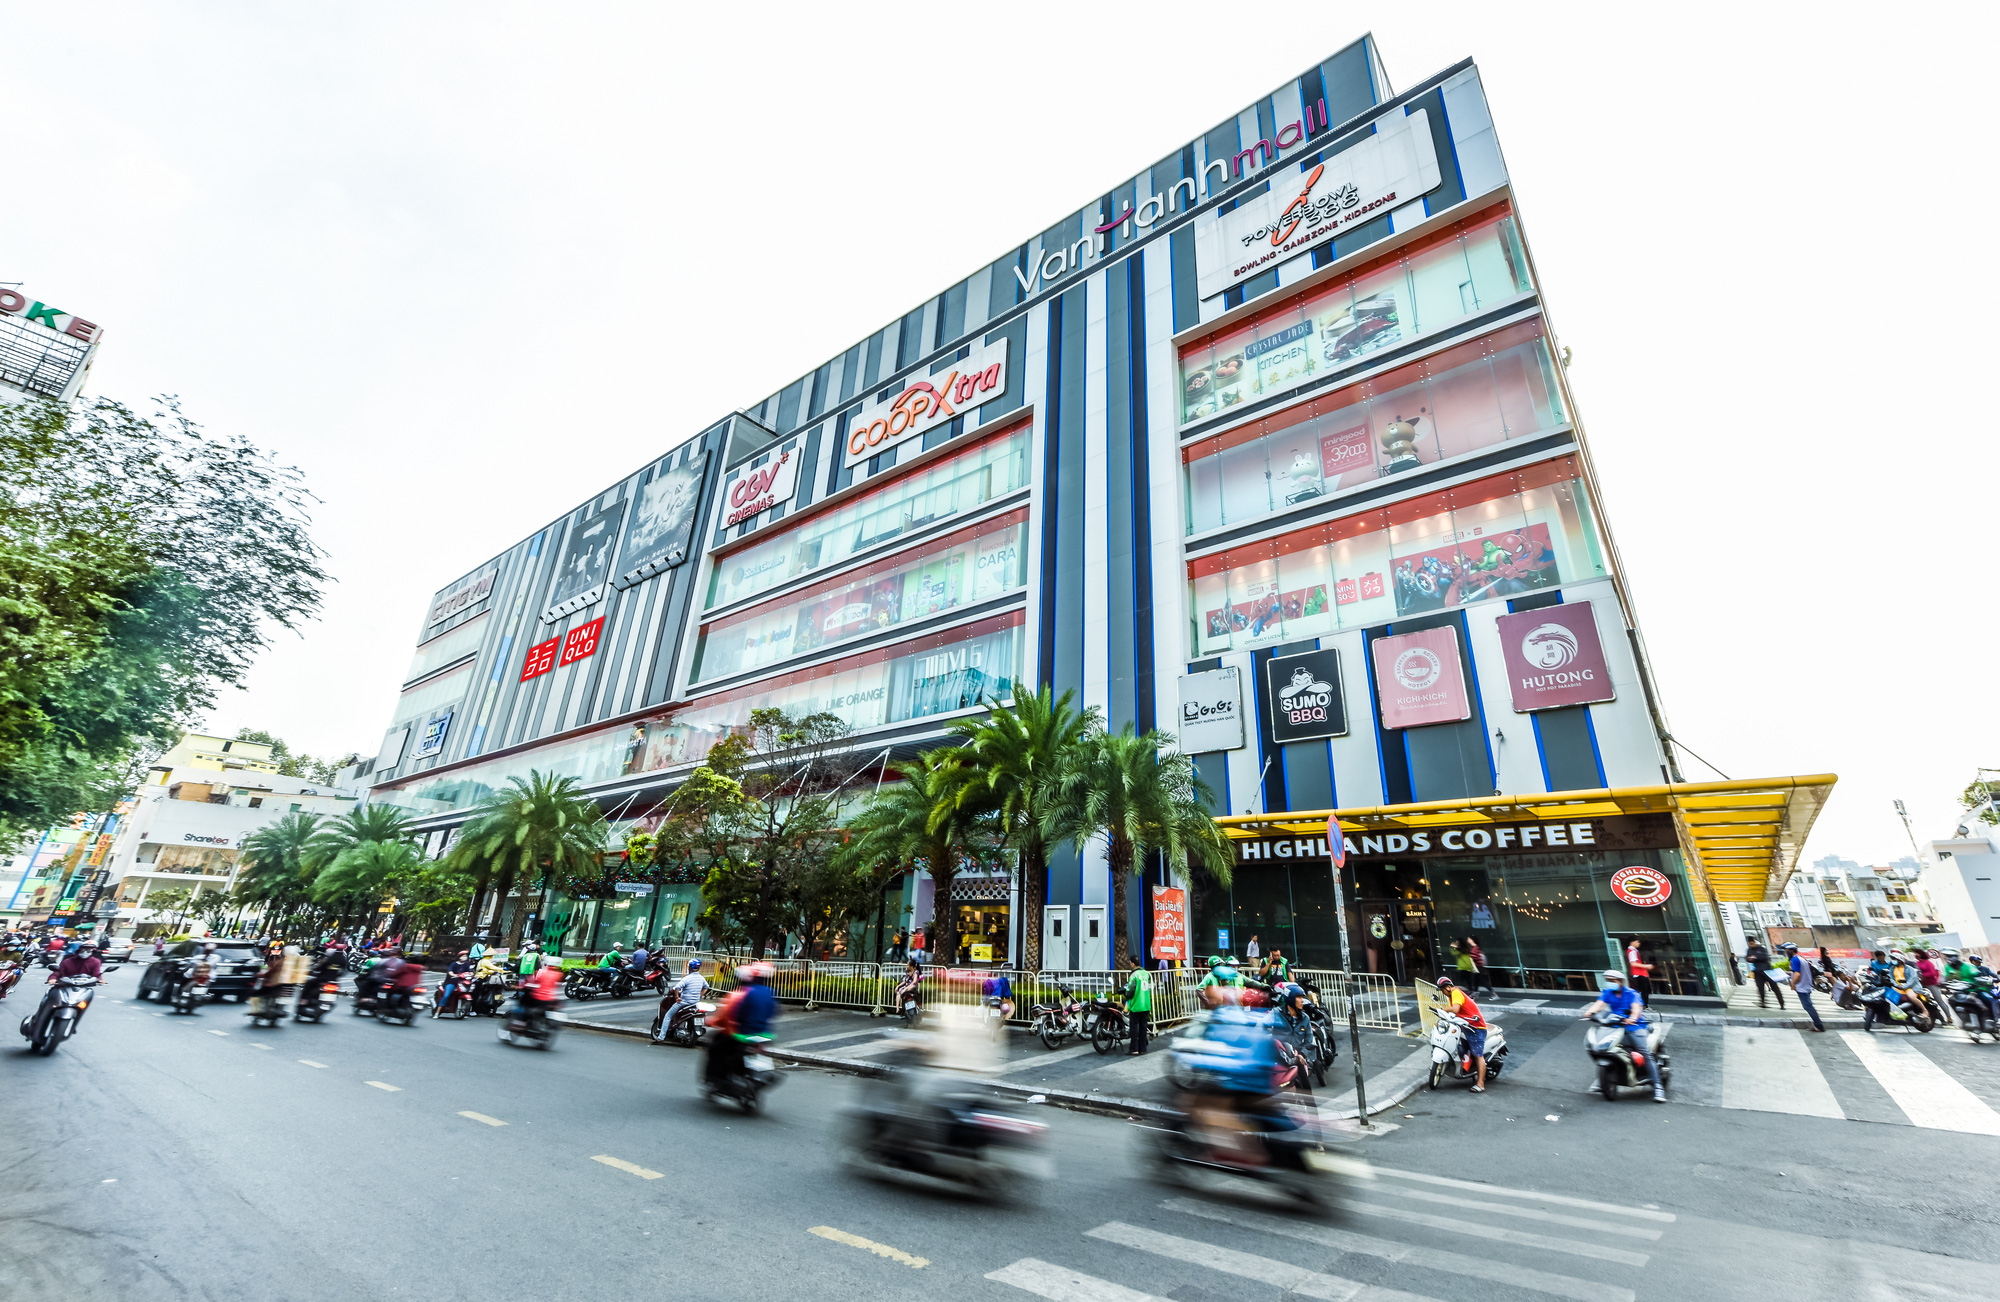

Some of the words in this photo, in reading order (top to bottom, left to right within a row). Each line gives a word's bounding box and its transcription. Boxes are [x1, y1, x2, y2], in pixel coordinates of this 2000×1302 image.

[1241, 181, 1358, 247] POWERBOWL
[1233, 250, 1277, 277] BOWLING
[1282, 219, 1339, 253] GAMEZONE
[1344, 191, 1397, 223] KIDSZONE
[0, 289, 97, 342] OKE
[1247, 334, 1283, 355] CRYSTAL
[1287, 321, 1309, 340] JADE
[1260, 346, 1307, 370] KITCHEN
[1324, 427, 1366, 447] minigood
[731, 462, 780, 508] CGV
[727, 493, 775, 525] CINEMAS
[981, 538, 1014, 553] HIKOSEN
[978, 547, 1016, 569] CARA
[431, 574, 494, 621] CITIGYM
[1336, 584, 1355, 593] MINI
[569, 623, 597, 644] UNI
[529, 642, 554, 662] ユニ
[565, 639, 594, 662] QLO
[524, 658, 551, 677] クロ
[1522, 669, 1594, 689] HUTONG
[825, 696, 844, 711] LIME
[846, 687, 886, 706] ORANGE
[1282, 693, 1329, 711] SUMO
[1290, 707, 1325, 723] BBQ
[91, 834, 112, 864] HOTEL
[184, 833, 230, 845] Sharetea
[1242, 833, 1431, 860] HIGHLANDS
[1440, 823, 1597, 850] COFFEE
[1613, 868, 1667, 886] HIGHLANDS
[1623, 893, 1666, 905] COFFEE
